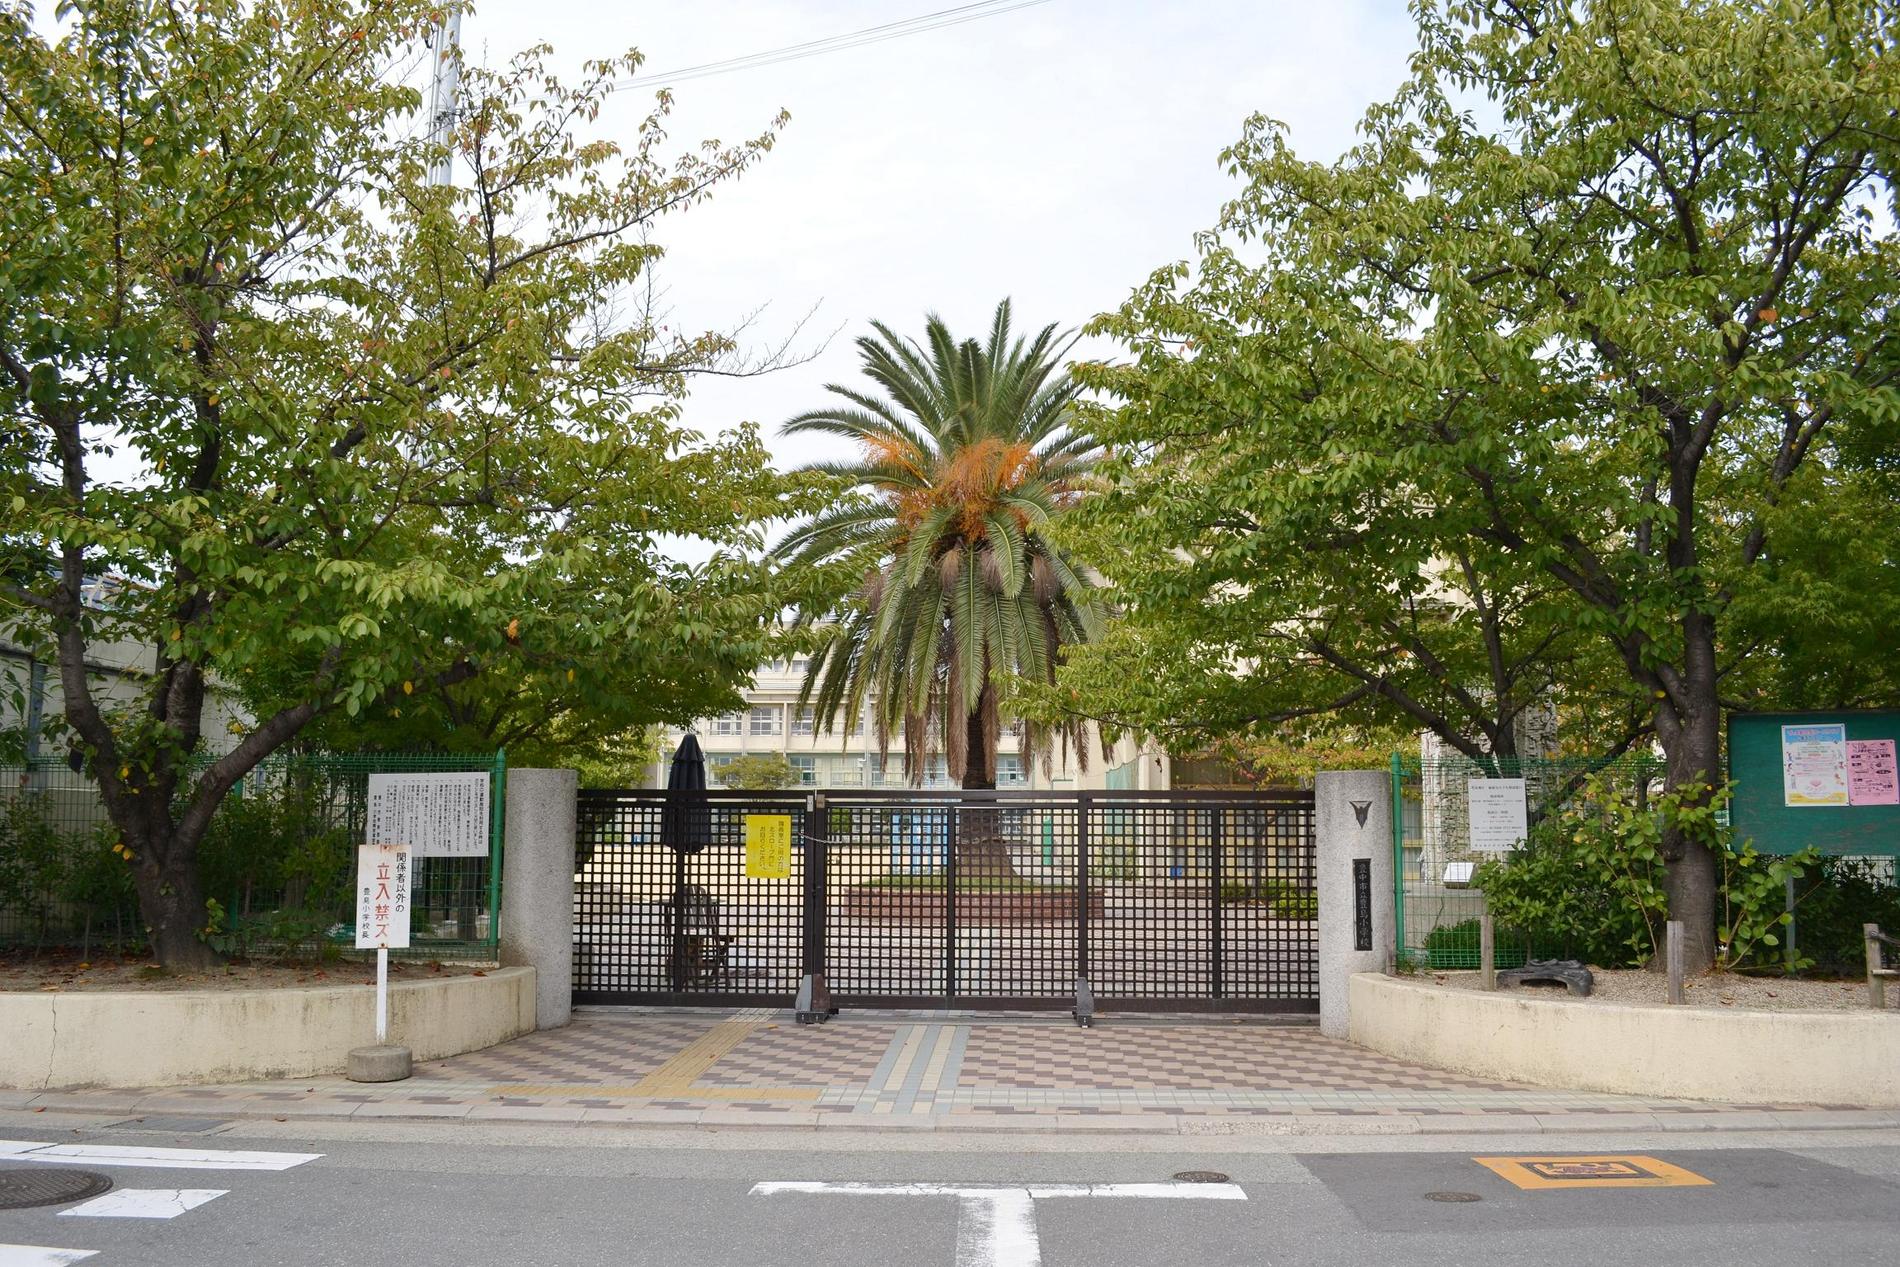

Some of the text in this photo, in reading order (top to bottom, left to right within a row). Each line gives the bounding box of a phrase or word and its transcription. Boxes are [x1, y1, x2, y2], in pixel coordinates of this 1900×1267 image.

[396, 852, 407, 913] 関係者以外の
